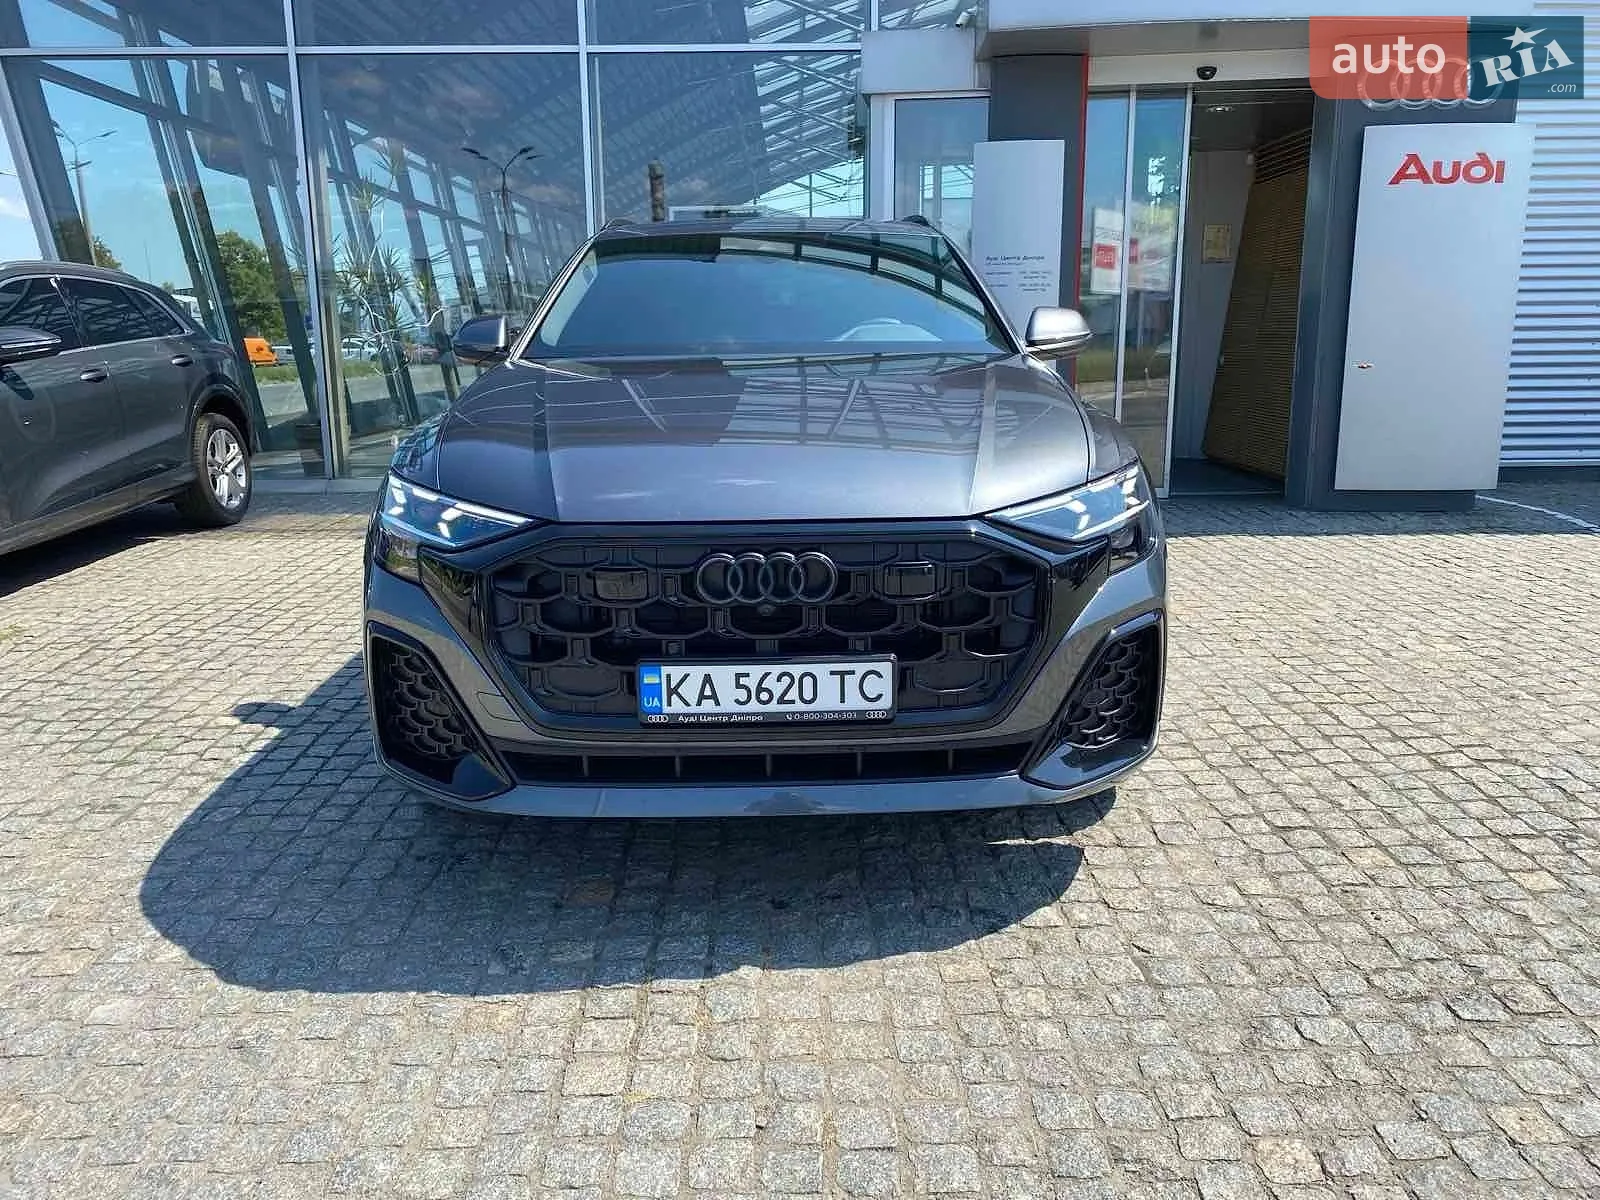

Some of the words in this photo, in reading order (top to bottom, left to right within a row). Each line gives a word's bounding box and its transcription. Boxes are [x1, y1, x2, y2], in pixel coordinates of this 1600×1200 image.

[1388, 152, 1506, 185] Audi
[666, 673, 721, 707] KA
[734, 671, 818, 706] 5620
[829, 669, 884, 703] TC
[644, 697, 660, 707] UA
[678, 715, 697, 723] Ауді
[730, 714, 763, 722] Дніпро
